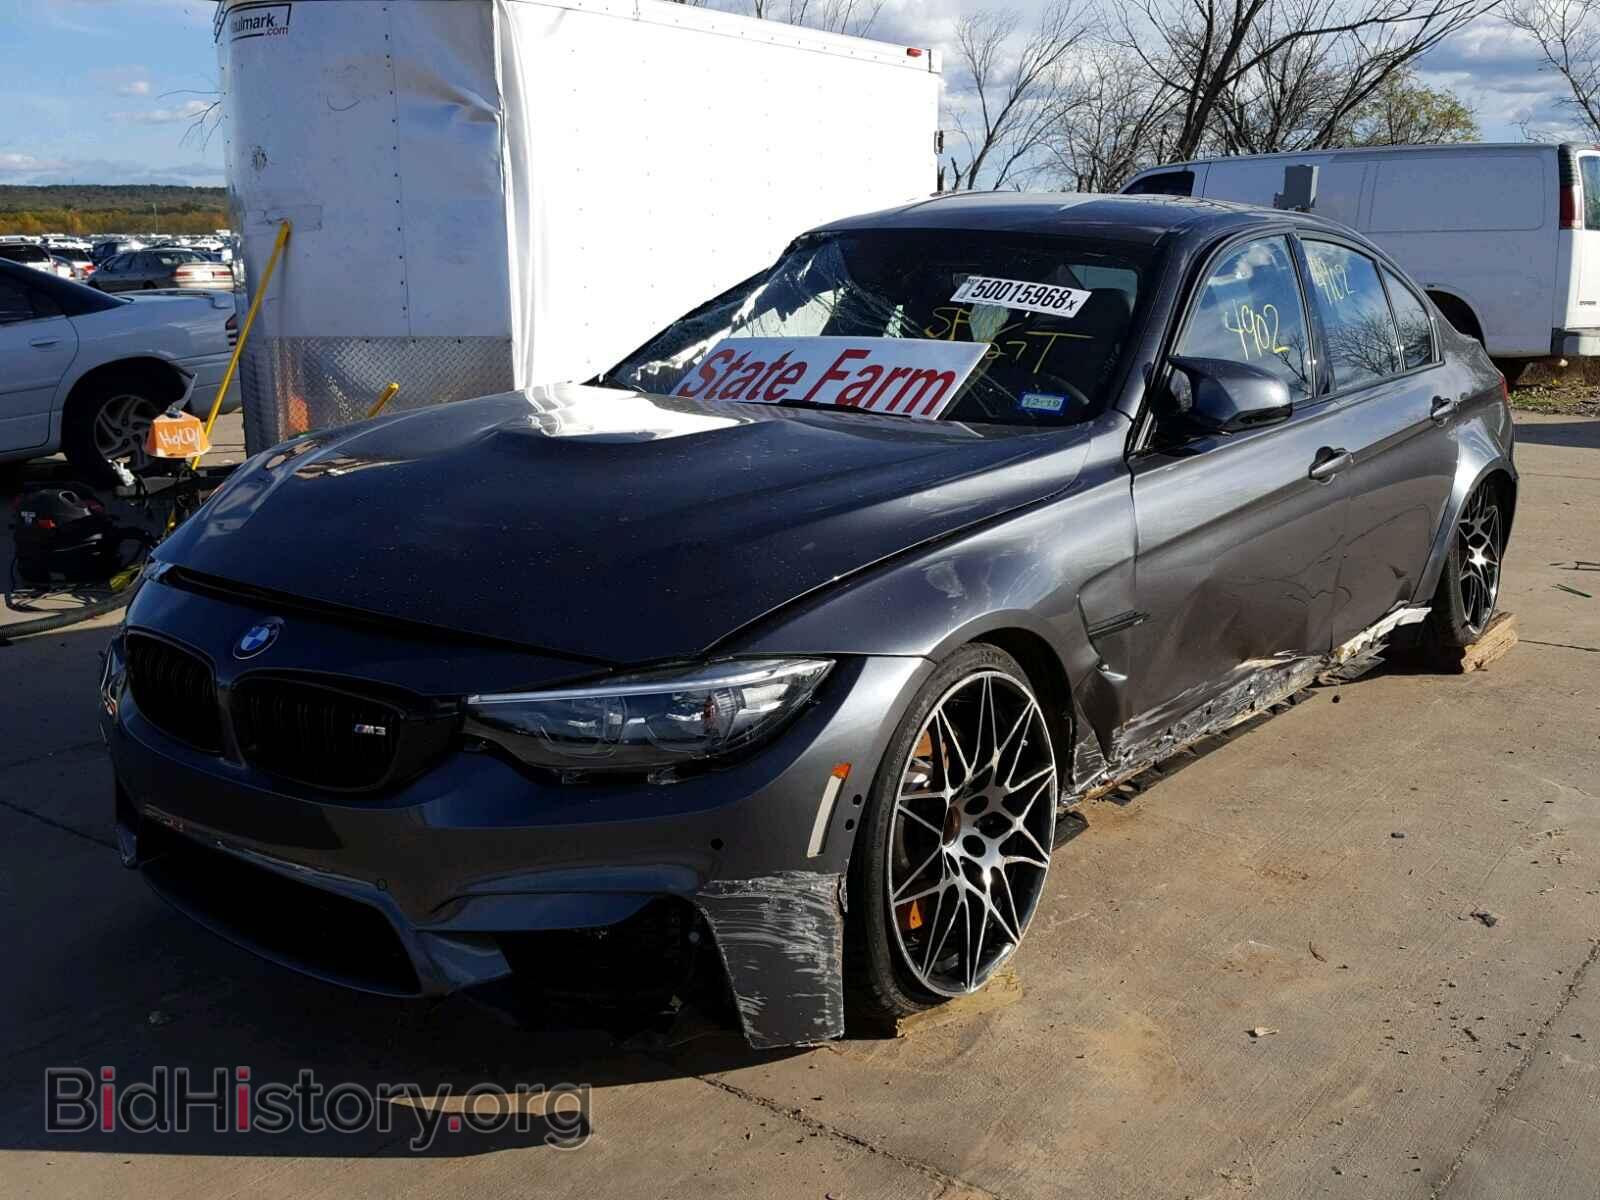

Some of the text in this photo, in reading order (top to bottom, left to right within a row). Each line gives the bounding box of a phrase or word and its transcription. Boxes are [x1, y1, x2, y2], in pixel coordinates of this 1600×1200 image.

[1224, 298, 1291, 361] 4902
[676, 348, 957, 416] State Farm
[355, 724, 386, 736] M3
